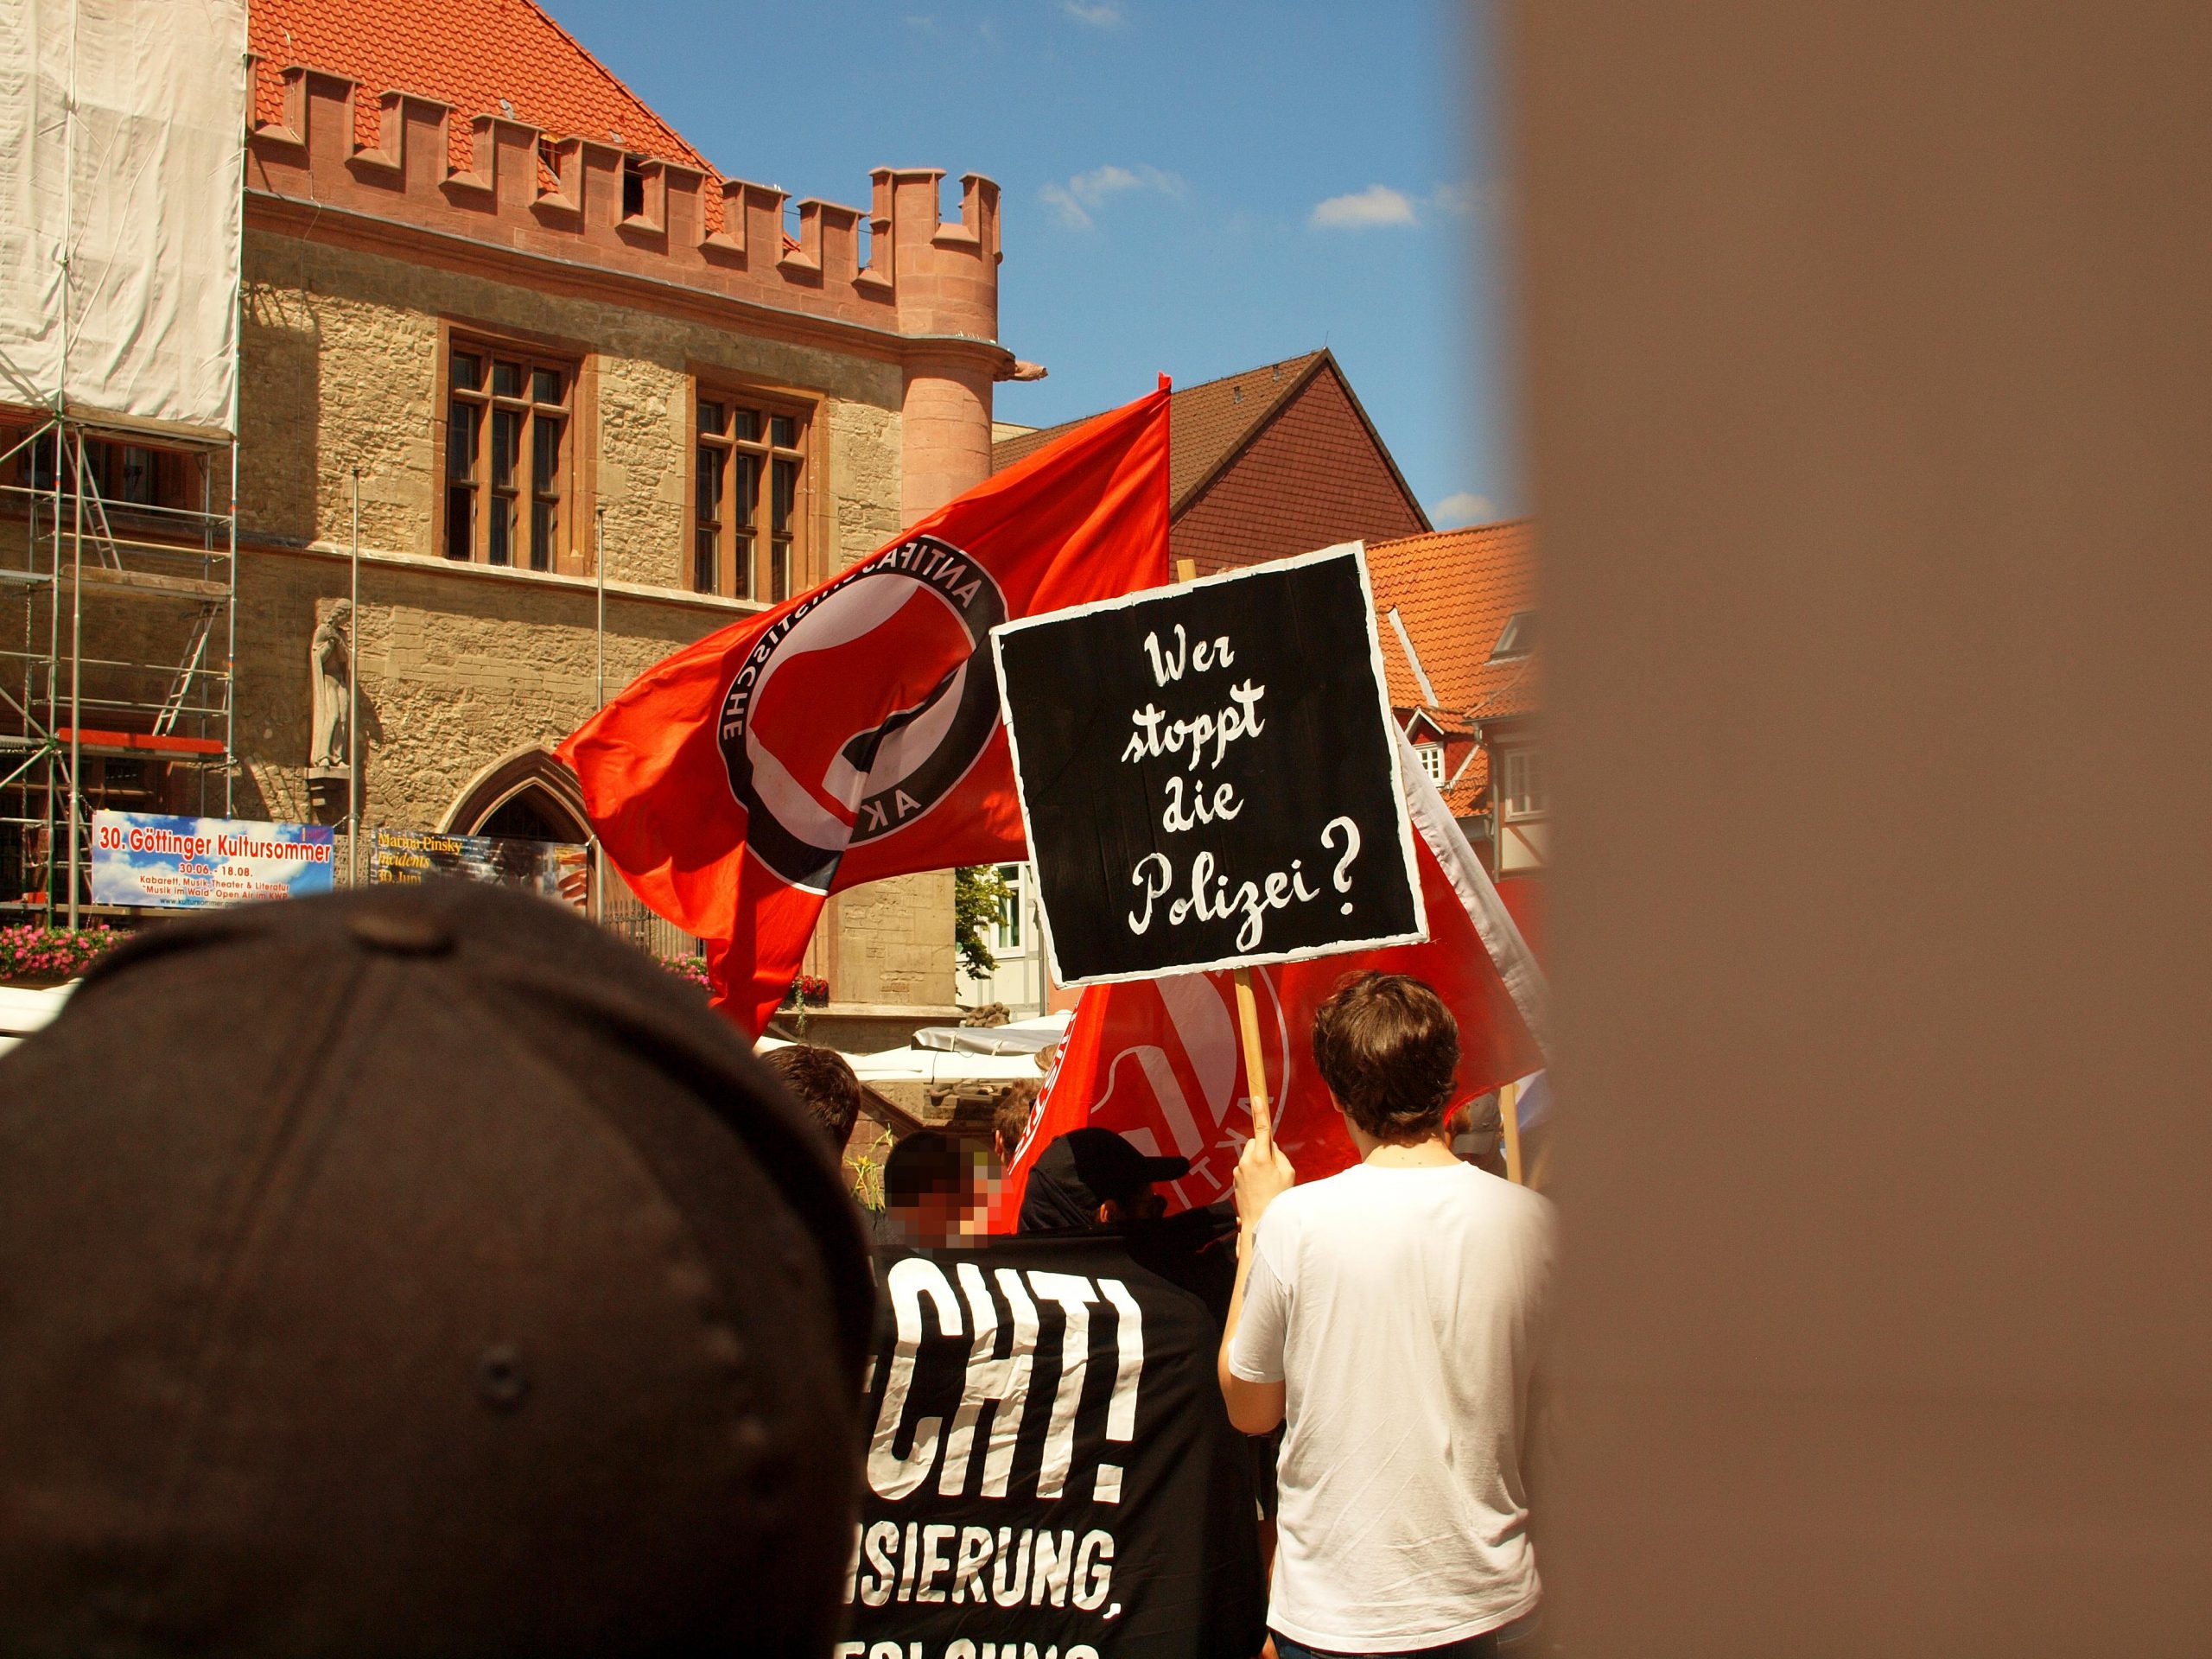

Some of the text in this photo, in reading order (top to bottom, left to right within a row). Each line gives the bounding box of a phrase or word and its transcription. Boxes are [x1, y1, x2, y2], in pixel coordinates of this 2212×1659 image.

[1144, 623, 1235, 687] Wer
[1121, 678, 1266, 771] stoppt
[1162, 776, 1244, 833] die
[99, 826, 126, 850] 30.
[130, 827, 212, 861] Göttinger
[218, 834, 331, 862] Kultursommer
[378, 832, 463, 856] Marina Pinsky
[140, 874, 181, 887] Kabarett,
[211, 880, 244, 889] Theater
[246, 881, 253, 890] &
[255, 882, 289, 892] Literatur
[180, 863, 213, 875] 30.06.
[222, 866, 253, 878] 18.08.
[215, 890, 239, 899] Open
